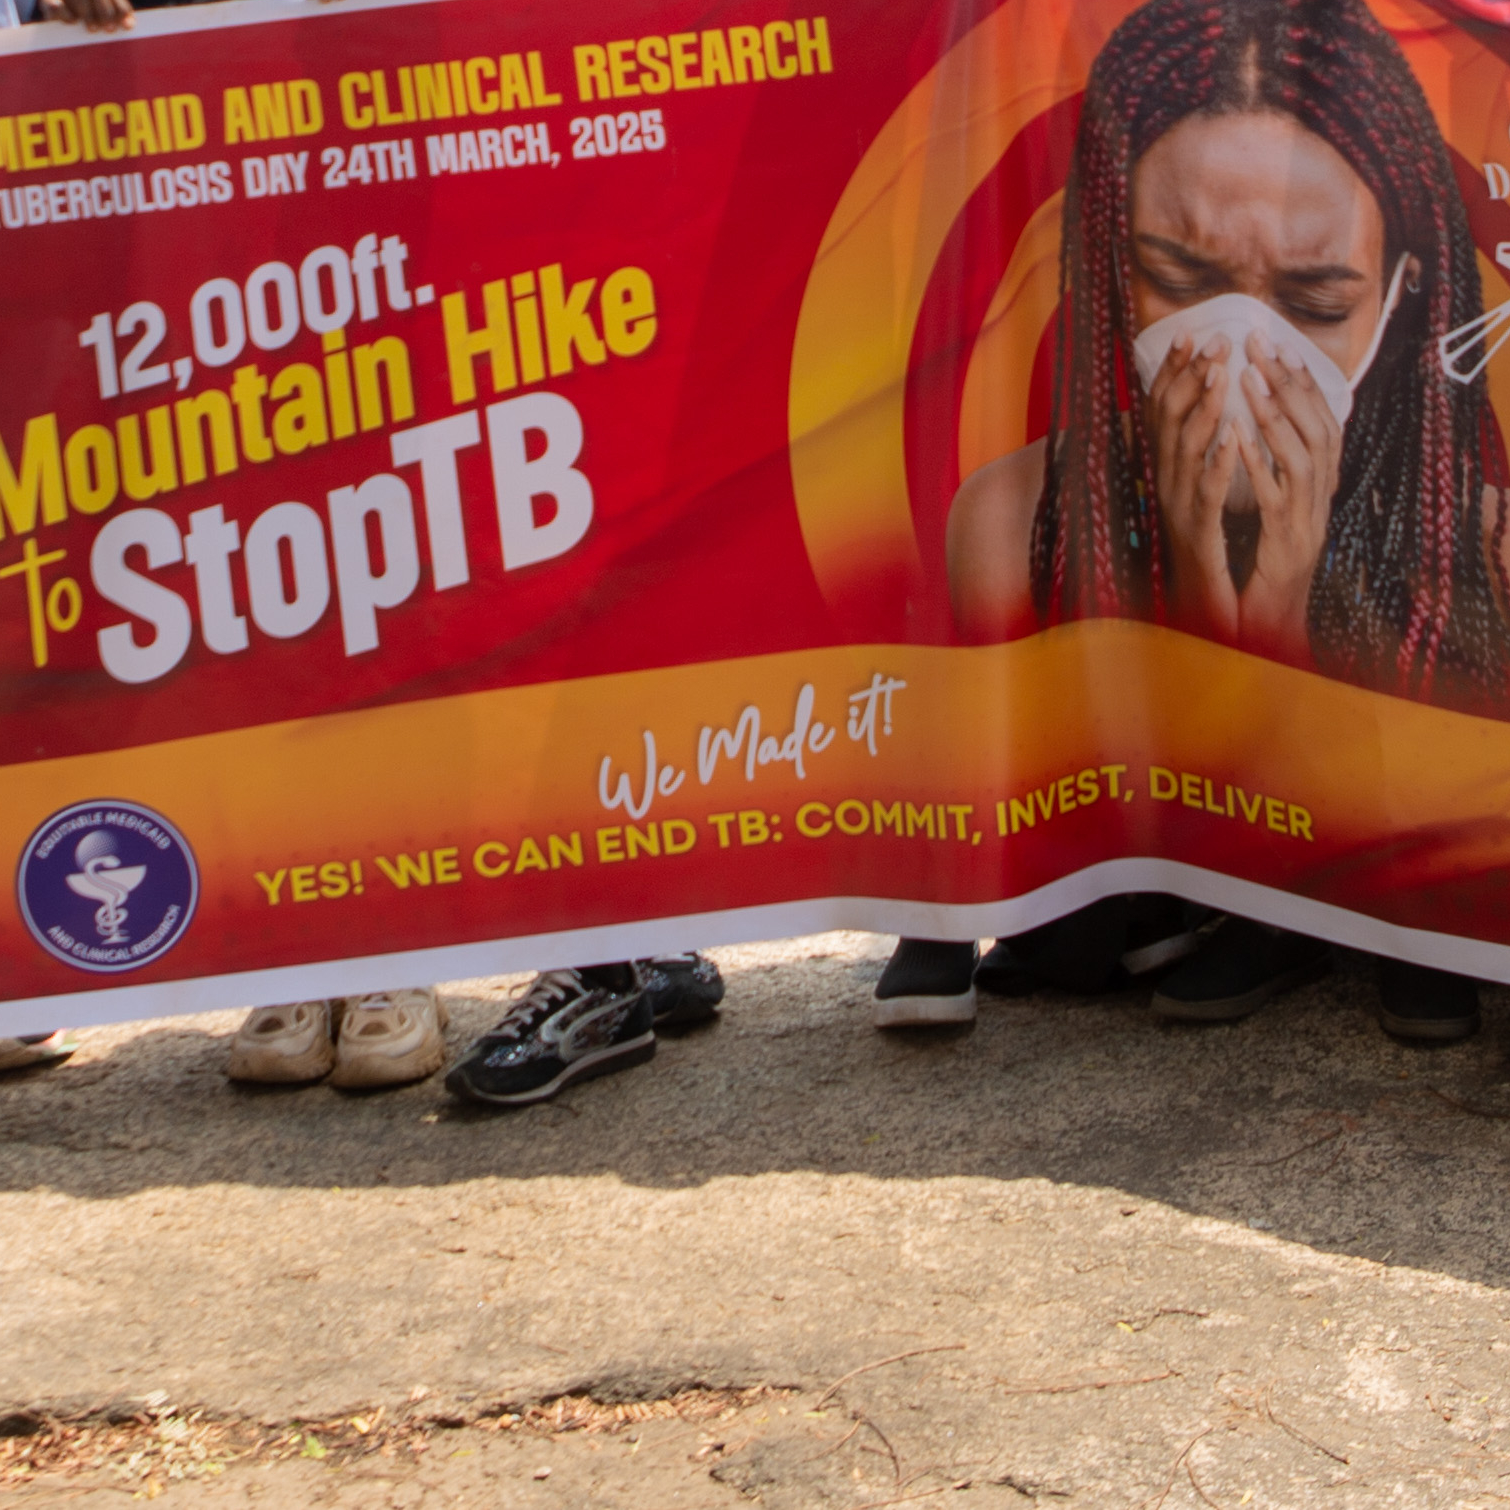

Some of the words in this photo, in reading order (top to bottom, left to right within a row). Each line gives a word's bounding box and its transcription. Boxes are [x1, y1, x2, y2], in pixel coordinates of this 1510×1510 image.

[224, 79, 324, 145] AND
[339, 51, 562, 130] CLINICAL
[573, 17, 833, 102] RESEARCH
[242, 151, 308, 198] DAY
[321, 139, 417, 189] 24TH
[426, 123, 562, 177] MARCH,
[570, 109, 666, 160] 2025
[79, 233, 435, 399] 12,000ft.
[440, 263, 657, 405] Hike
[599, 730, 685, 820] We
[698, 683, 835, 785] Made
[848, 673, 907, 756] it!
[104, 811, 171, 850] MEDICAID
[255, 860, 366, 905] YES!
[376, 847, 461, 890] WE
[473, 831, 584, 878] CAN
[596, 819, 696, 863] END
[707, 809, 784, 848] TB:
[795, 798, 982, 846] COMMIT,
[996, 765, 1135, 836] INVEST,
[1148, 766, 1314, 842] DELIVER
[47, 925, 75, 949] AND
[72, 942, 131, 962] CLINICAL
